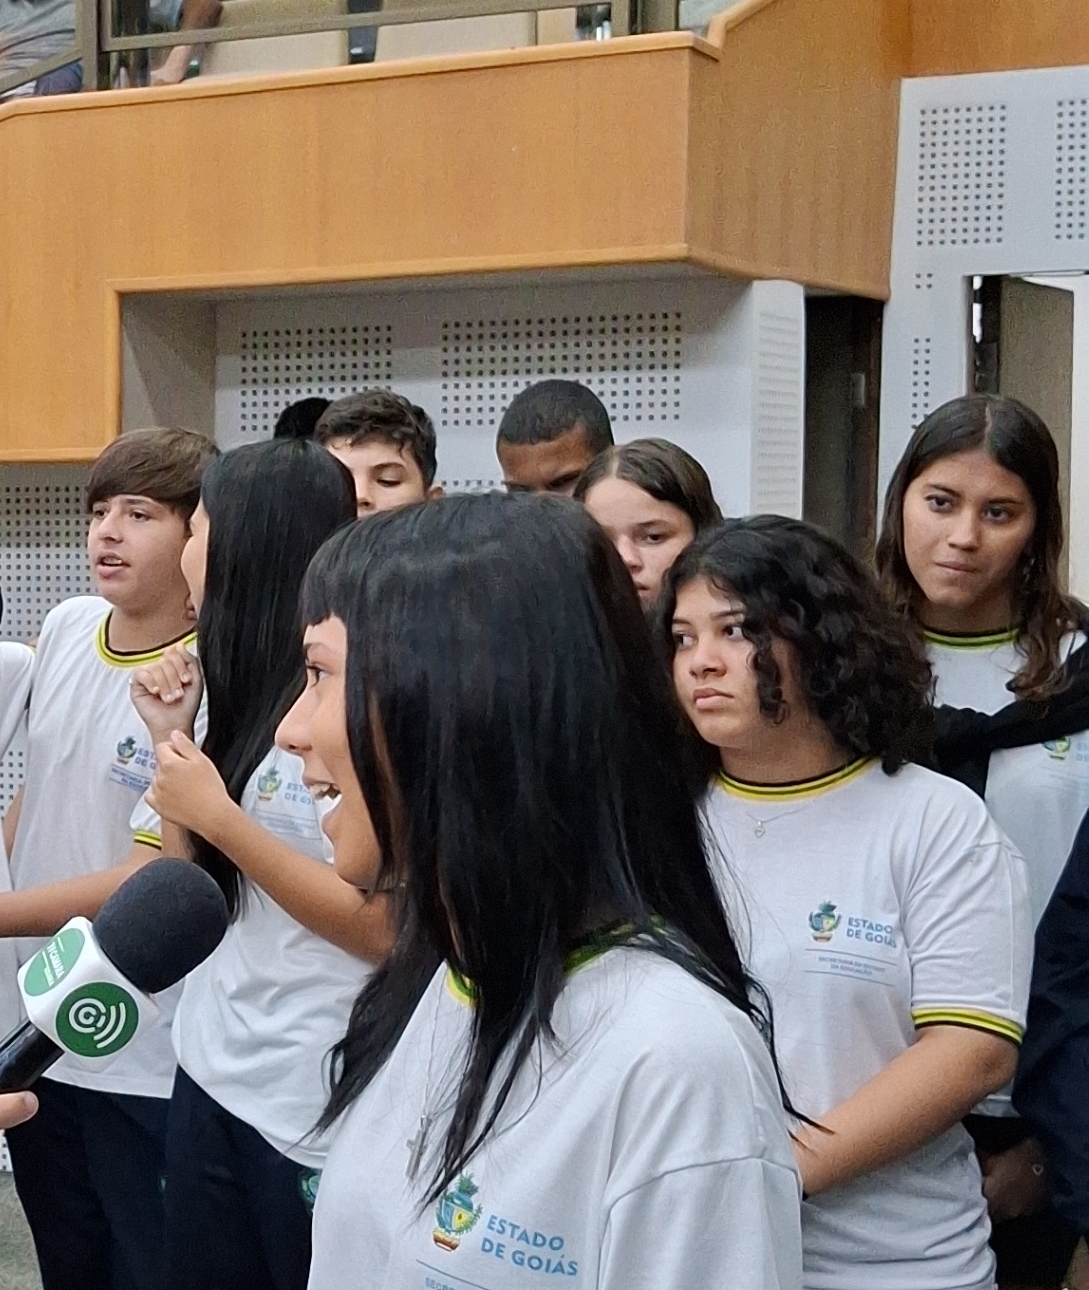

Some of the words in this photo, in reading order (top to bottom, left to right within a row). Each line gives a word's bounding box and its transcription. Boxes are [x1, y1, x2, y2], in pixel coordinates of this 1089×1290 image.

[846, 927, 862, 940] DE
[847, 917, 893, 934] ESTADO
[486, 1214, 565, 1251] ESTADO
[480, 1237, 506, 1260] DE
[511, 1249, 579, 1276] GOIÁS
